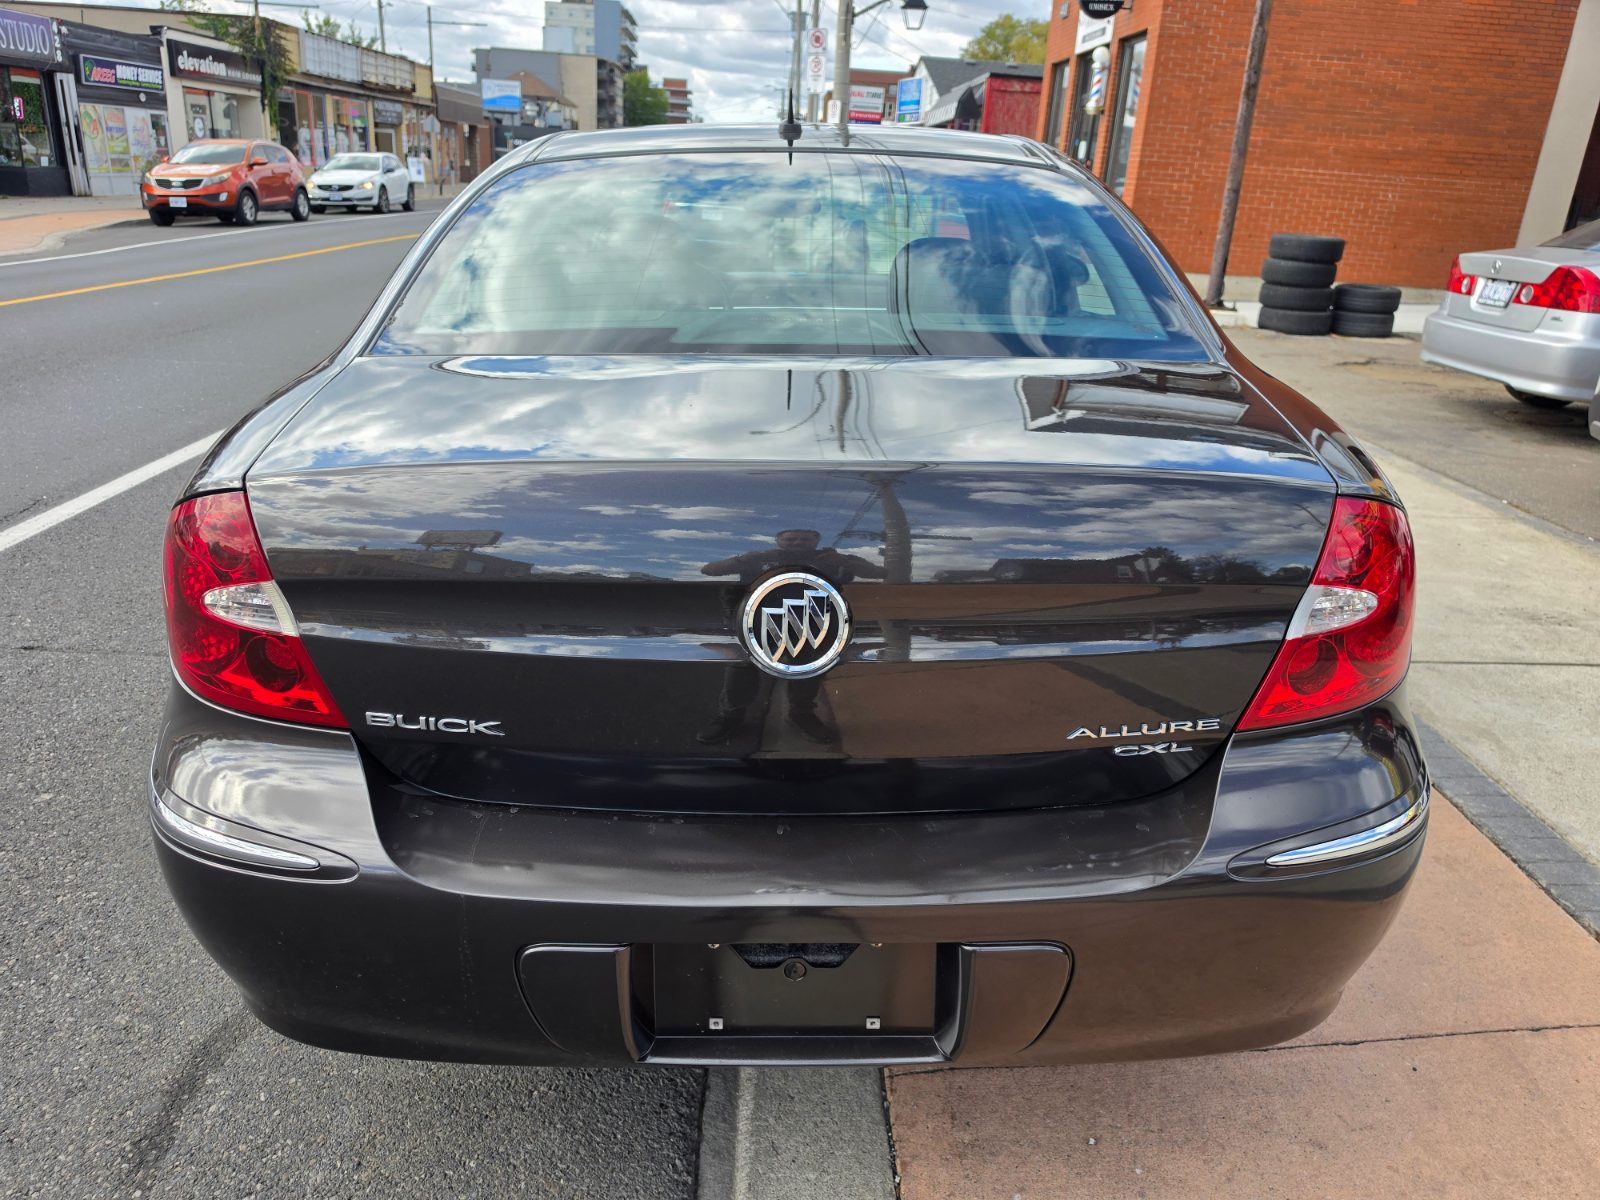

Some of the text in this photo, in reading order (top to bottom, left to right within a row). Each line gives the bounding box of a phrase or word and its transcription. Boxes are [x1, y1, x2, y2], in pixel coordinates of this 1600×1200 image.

[0, 18, 50, 55] STUDIO
[116, 64, 138, 81] MONEY
[138, 67, 163, 84] SERVICE
[177, 50, 227, 77] elevation
[365, 711, 506, 736] BUICK
[1066, 718, 1220, 740] ALLURE
[1114, 741, 1193, 757] CXL
